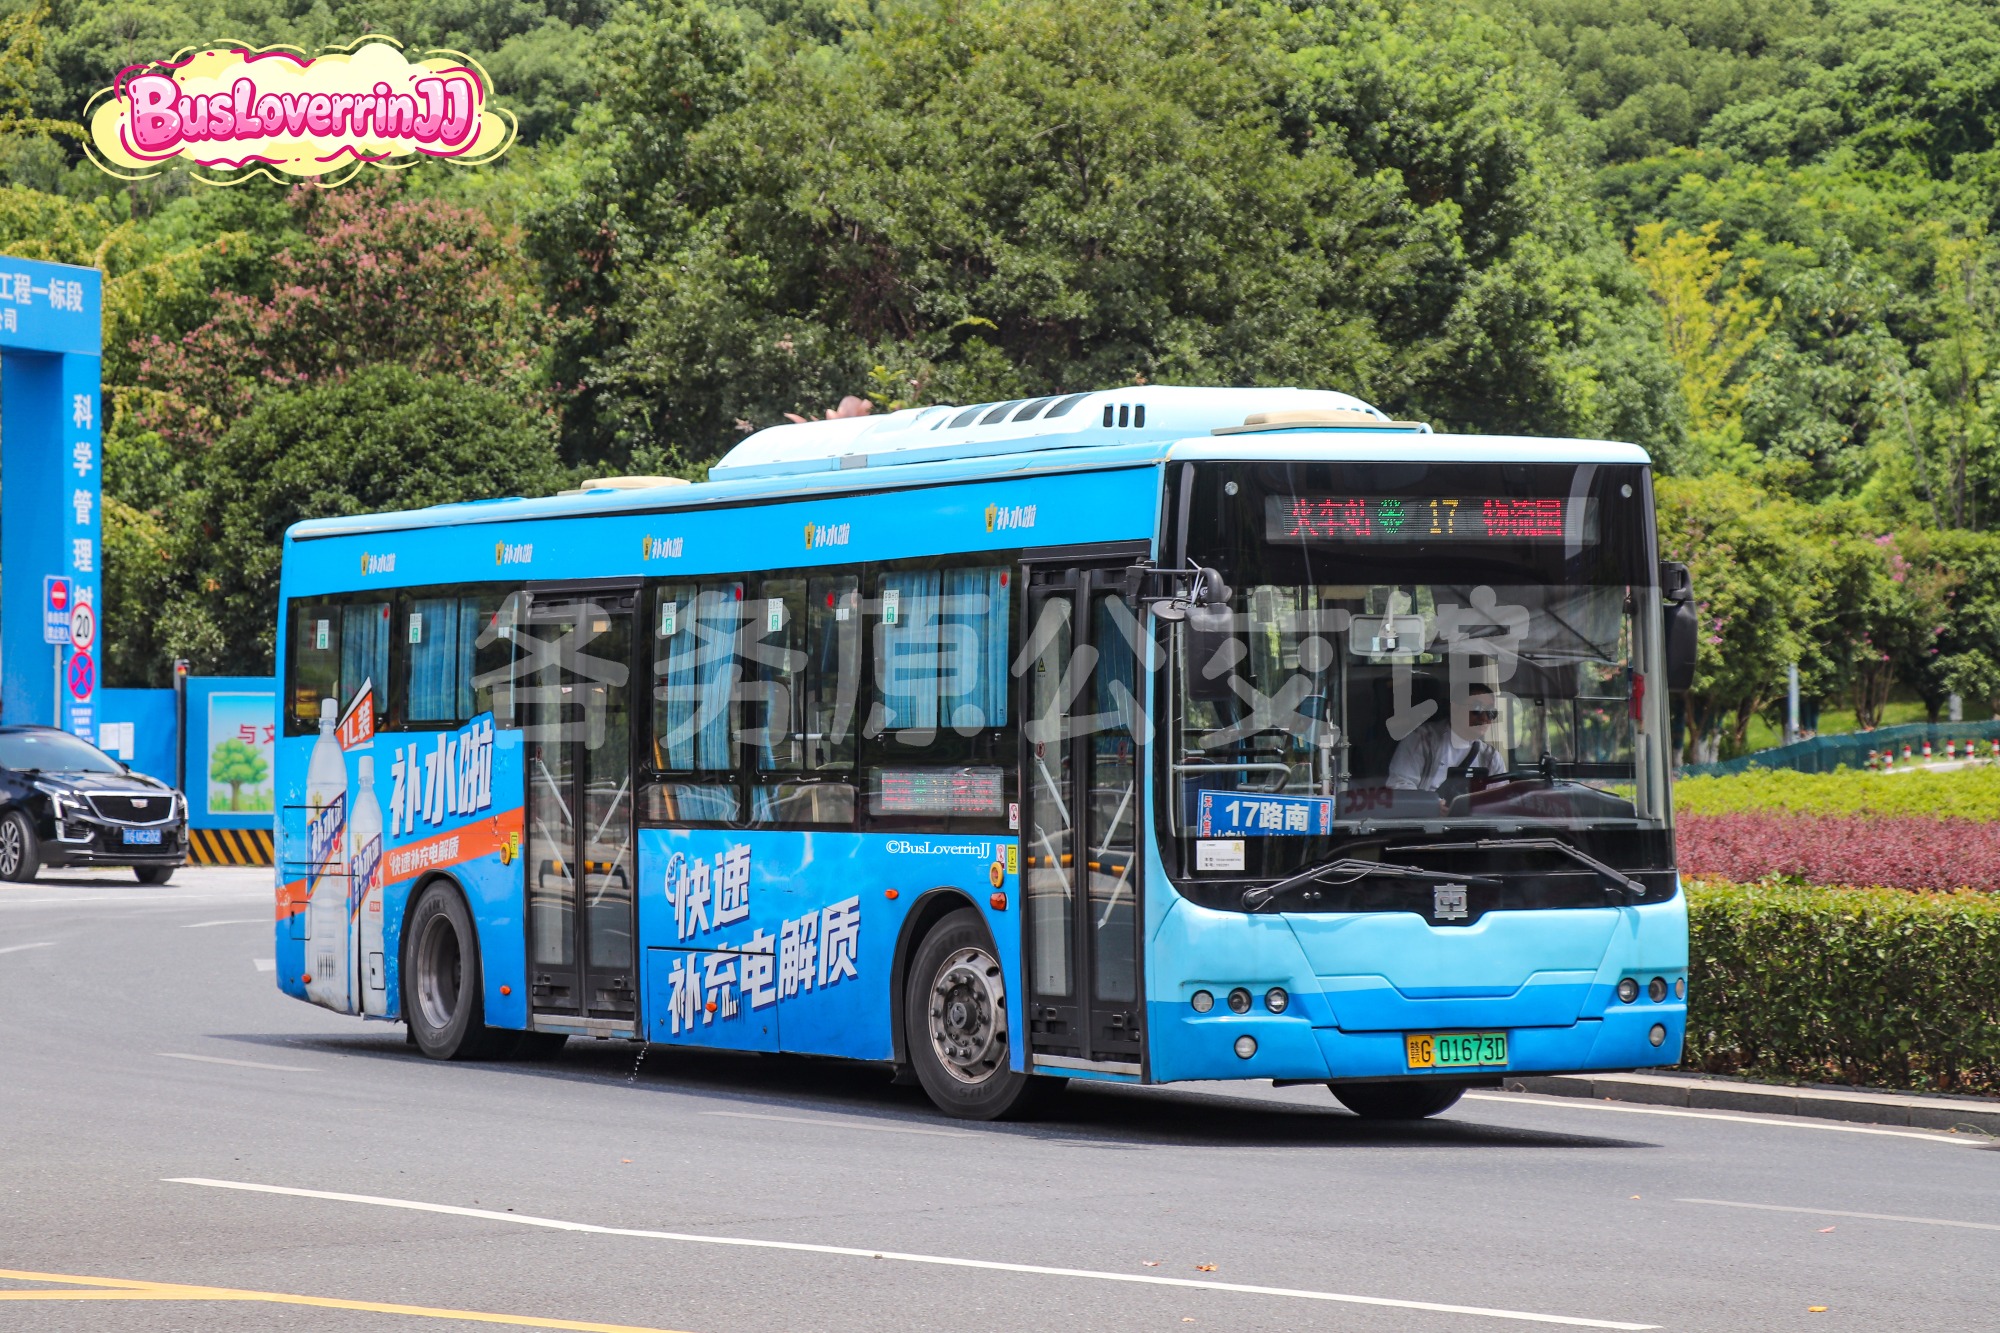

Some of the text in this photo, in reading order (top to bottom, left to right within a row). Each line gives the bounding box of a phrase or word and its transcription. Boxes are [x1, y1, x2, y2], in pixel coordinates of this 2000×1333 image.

[0, 273, 83, 313] 工程一标段
[0, 308, 17, 333] 司
[997, 504, 1036, 530] 补水啦
[1290, 498, 1371, 536] 火车站
[1429, 499, 1459, 534] 17
[652, 537, 683, 559] 补水啦
[815, 522, 850, 548] 补水啦
[504, 543, 533, 564] 补水啦
[76, 614, 89, 638] 20
[342, 699, 371, 748] 1L装
[390, 718, 494, 837] 补水啦
[1225, 800, 1310, 832] 17路南
[389, 836, 459, 877] 快速补充电解质
[674, 843, 751, 940] 快速
[667, 896, 860, 1035] 补充电解质
